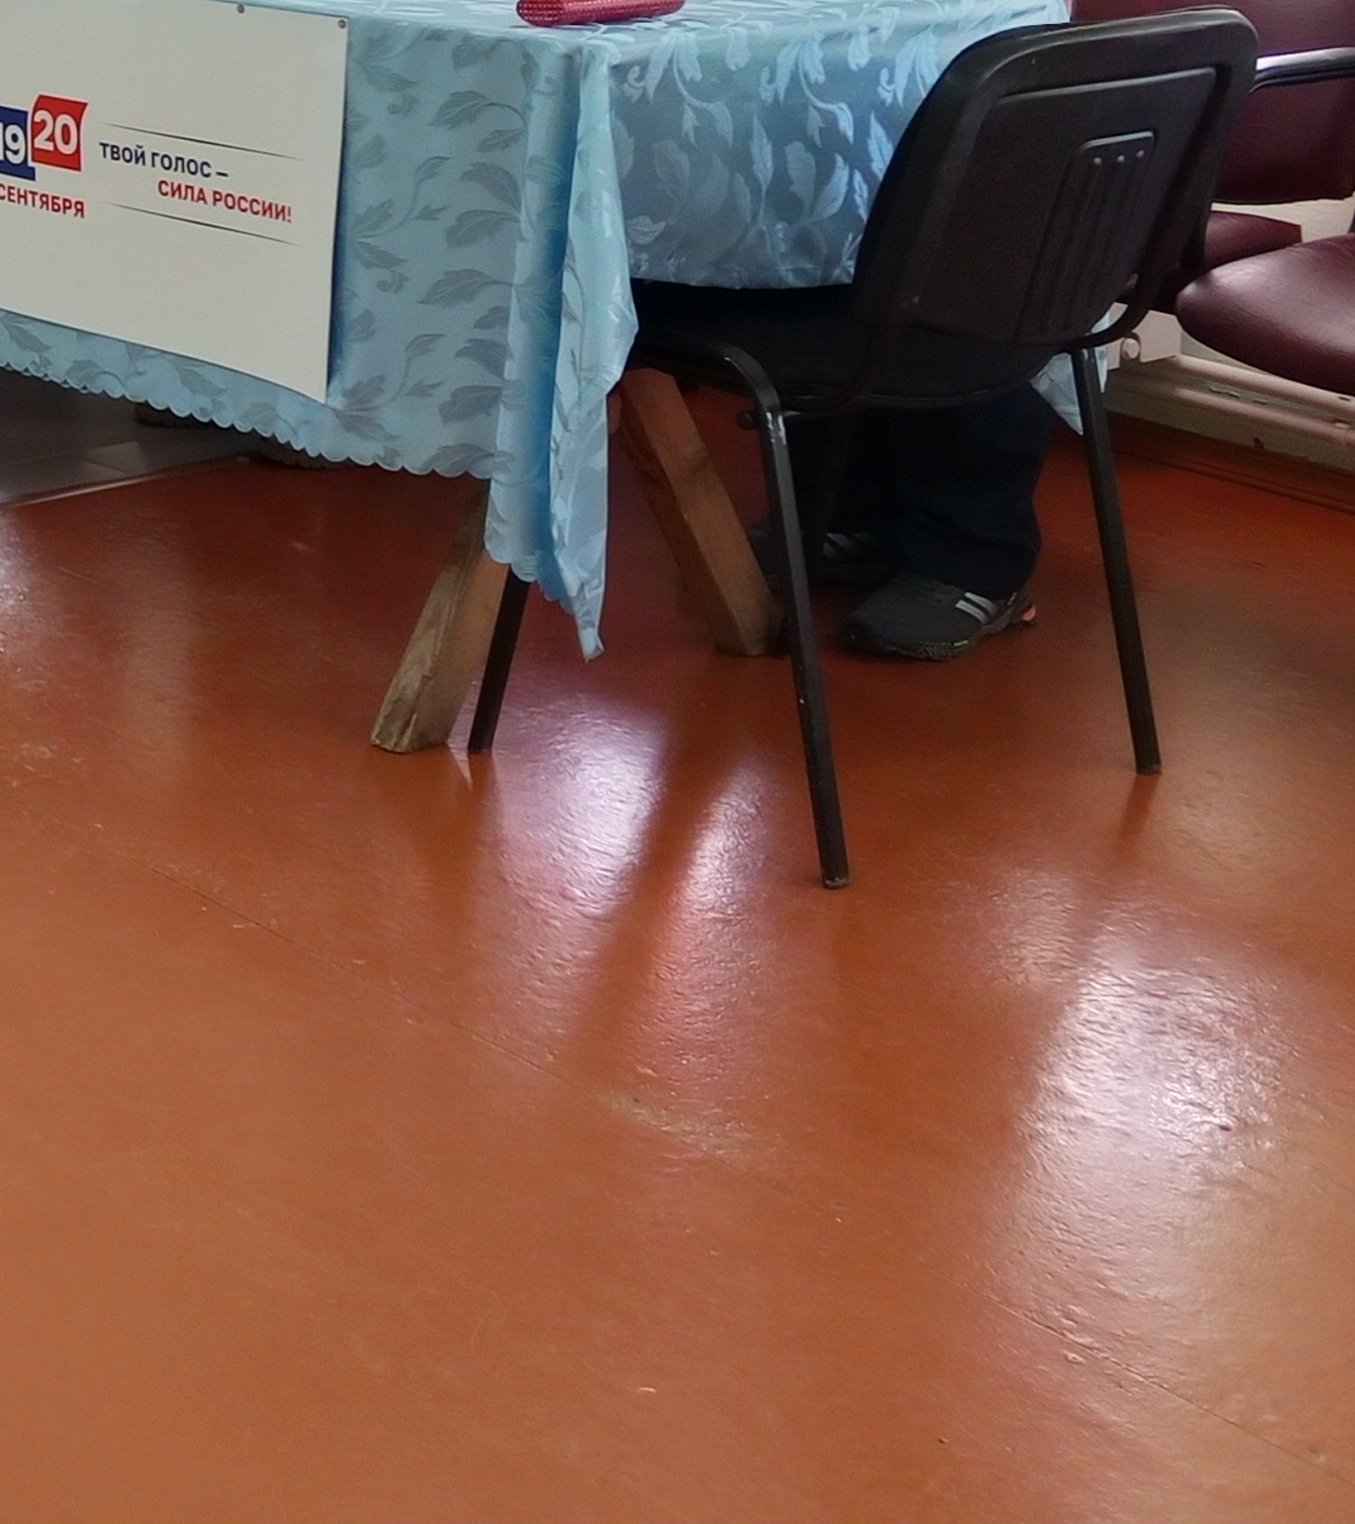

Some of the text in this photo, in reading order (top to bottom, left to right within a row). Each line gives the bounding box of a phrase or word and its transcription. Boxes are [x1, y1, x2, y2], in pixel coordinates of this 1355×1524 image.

[33, 109, 78, 155] 20
[99, 141, 146, 166] ТВОЙ
[151, 152, 212, 178] ГОЛОС
[158, 179, 292, 223] СИЛА РОССИИ!
